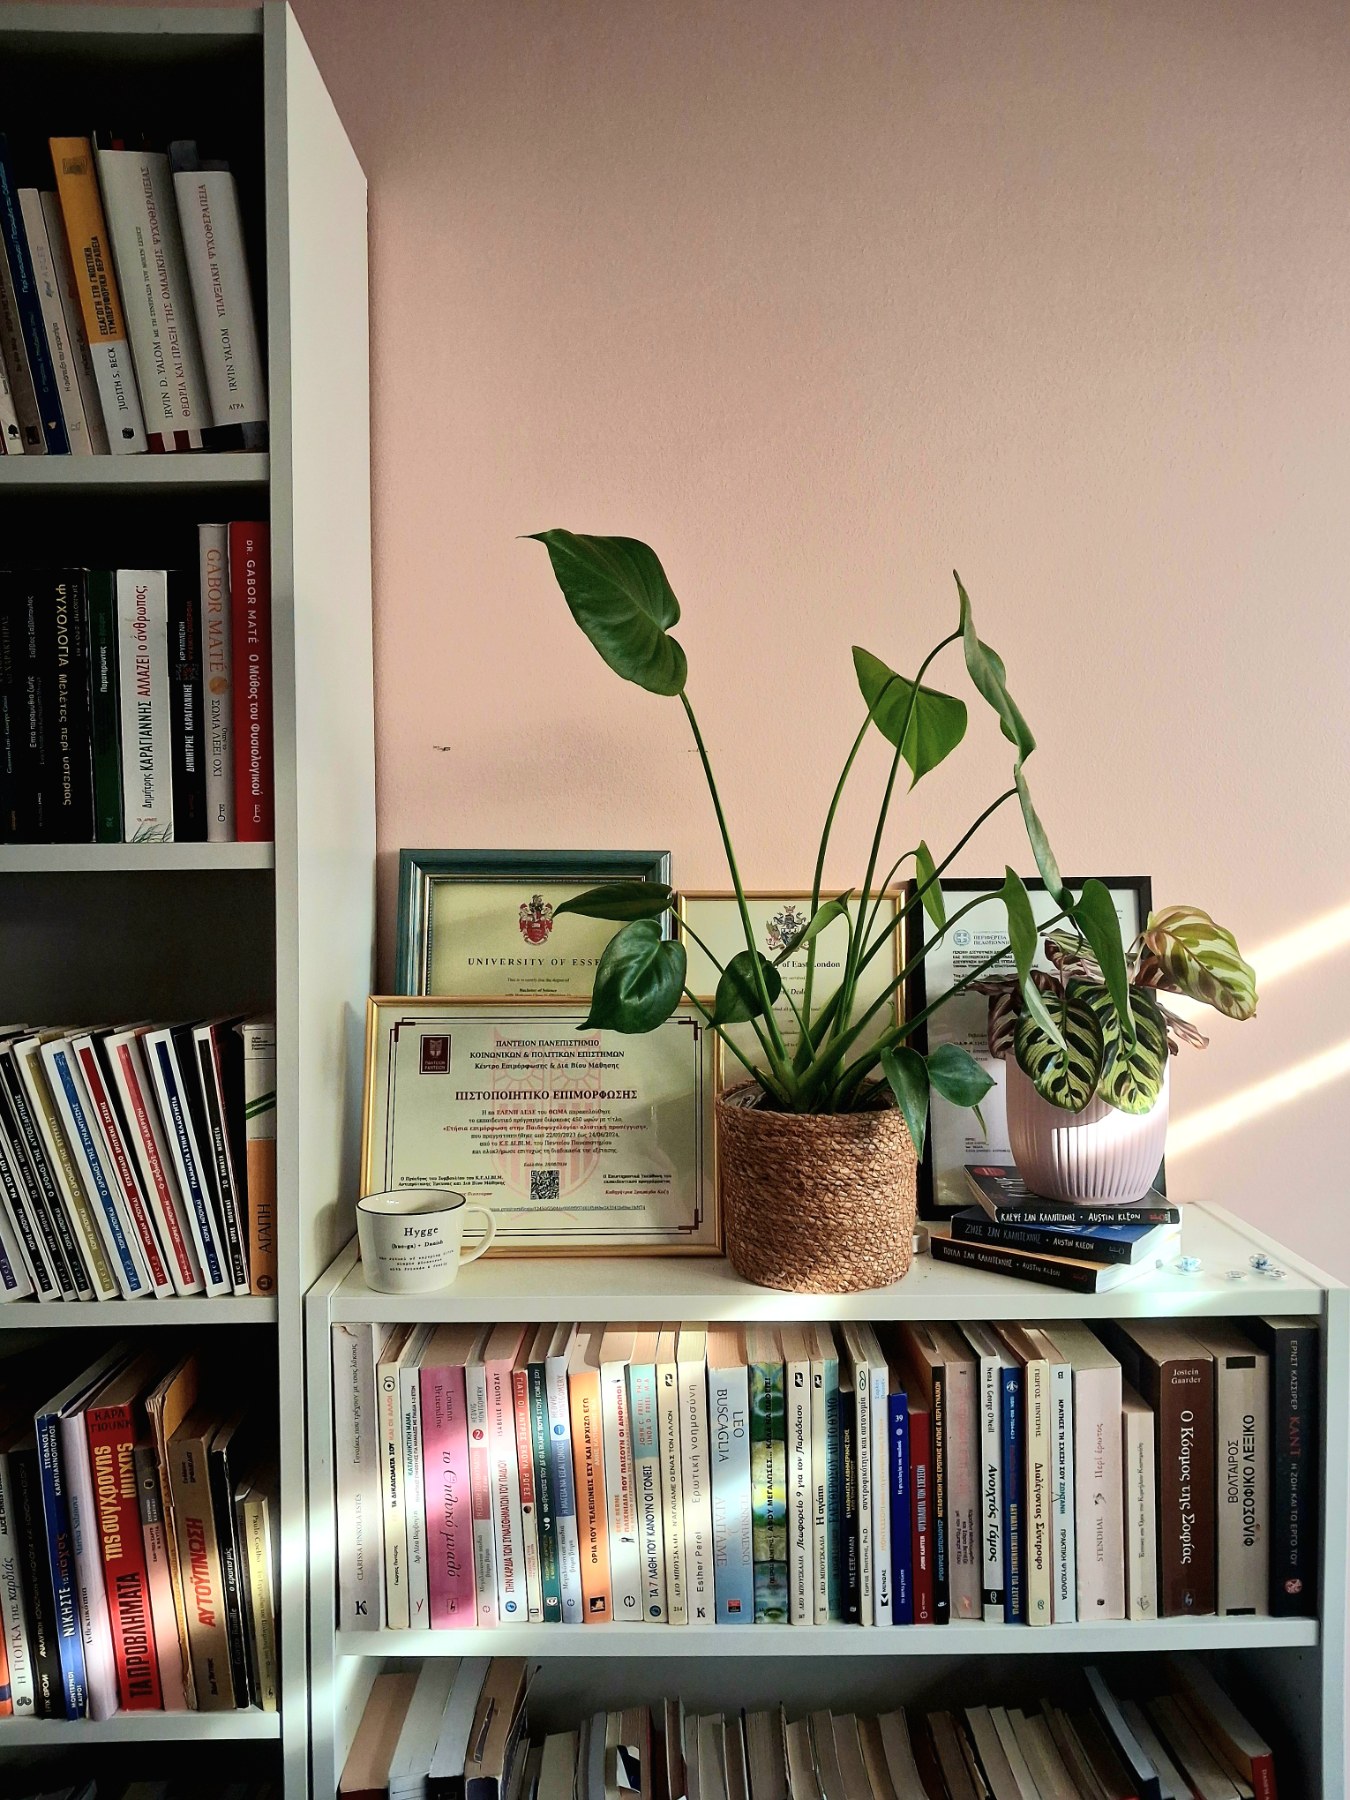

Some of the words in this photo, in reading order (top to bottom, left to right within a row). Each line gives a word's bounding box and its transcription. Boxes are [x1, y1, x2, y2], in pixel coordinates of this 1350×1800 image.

[140, 166, 162, 245] ΨΥΧΟΘΕΡΑΠΕΙΑΣ
[198, 183, 217, 259] ΨΥΧΟΘΕΡΑΠΕΙΑ
[84, 247, 100, 283] ΓΝΩΣΤΙΚΗ
[91, 236, 107, 272] ΘΕΡΑΠΕΙΑ
[154, 248, 171, 300] ΟΜΑΔΙΚΗΣ
[92, 284, 103, 298] ΣΤΗ
[99, 274, 117, 335] ΣΥΜΠΕΡΙΦΟΡΙΚΗ
[210, 263, 226, 318] ΥΠΑΡΞΙΑΚΗ
[96, 300, 109, 335] ΕΙΣΑΓΩΓΗ
[163, 303, 176, 323] ΤΗΣ
[108, 347, 119, 368] BECK
[152, 341, 166, 374] YALOM
[168, 325, 181, 359] ΠΡΑΞΗ
[220, 328, 232, 362] YALOM
[112, 370, 120, 378] S.
[158, 377, 168, 387] D.
[175, 362, 184, 378] ΚΑΙ
[227, 364, 237, 392] IRVIN
[113, 380, 129, 411] JUDITH
[161, 392, 174, 419] IRVIN
[178, 381, 191, 417] ΘΕΩΡΙΑ
[207, 549, 223, 613] GABOR
[246, 559, 257, 605] GABOR
[55, 583, 69, 667] ΨΥΧΟΛΟΓΙΑ
[131, 585, 148, 642] άνθρωπος;
[247, 609, 258, 644] MATÉ
[209, 619, 226, 672] MATÉ
[249, 654, 258, 662] Ο
[136, 654, 151, 696] ΑΛΛΑΖΕΙ
[249, 665, 260, 700] Μύθος
[58, 673, 69, 722] Μελέτες
[183, 684, 194, 731] ΚΑΡΑΓΙΑΝΝΗΣ
[250, 702, 260, 720] του
[211, 700, 221, 730] ΣΩΜΑ
[59, 727, 71, 751] περί
[138, 701, 152, 771] ΚΑΡΑΓΙΑΝΝΗΣ
[212, 731, 222, 756] ΛΕΕΙ
[184, 735, 195, 772] ΔΗΜΗΤΡΗΣ
[212, 758, 222, 777] ΟΧΙ
[249, 723, 263, 796] Φυσιολογικού
[61, 756, 73, 806] υστερίας
[142, 773, 153, 809] Δημήτρης
[468, 958, 545, 966] UNIVERSITY
[551, 958, 566, 966] OF
[572, 958, 601, 966] ESSE
[475, 1062, 499, 1070] Κέντρο
[501, 1062, 548, 1070] Επιμόρφωσης
[454, 1090, 550, 1101] ΠΙΣΤΟΠΟΙΗΤΙΚΟ
[553, 1090, 638, 1100] ΕΠΙΜΟΡΦΩΣΗΣ
[72, 1102, 91, 1146] ΣΥΝΑΝΤΗΣΗΣ
[100, 1101, 113, 1123] ΣΧΕΣΗΣ
[171, 1096, 185, 1135] ΚΛΑΟΥΝΤΙΑ
[88, 1146, 97, 1160] ΤΗΣ
[108, 1125, 122, 1154] ΕΡΩΤΙΚΗΣ
[181, 1135, 192, 1153] ΣΤΗΝ
[93, 1161, 106, 1188] ΔΡΟΜΟΣ
[118, 1155, 133, 1187] ΕΓΧΕΙΡΙΔΙΟ
[185, 1154, 198, 1189] ΓΡΑΜΜΑΤΑ
[257, 1203, 272, 1254] ΑΓΑΠΗ
[1023, 1213, 1036, 1222] ΣΑΝ
[1088, 1212, 1115, 1222] AUSTIN
[1118, 1211, 1141, 1221] KLEON
[404, 1227, 439, 1239] Hygge
[987, 1227, 1001, 1238] ΣΑΝ
[1053, 1237, 1074, 1247] AUSTIN
[1075, 1240, 1095, 1250] KLEON
[963, 1250, 976, 1260] ΣΑΝ
[1022, 1261, 1041, 1272] AUSTIN
[1042, 1266, 1061, 1277] KLEON
[1289, 1340, 1298, 1367] ΕΡΝΣΤ
[1171, 1376, 1203, 1384] Gaarder
[1173, 1368, 1199, 1376] Jostein
[446, 1390, 455, 1422] Louann
[582, 1397, 590, 1414] ΕΓΩ
[1290, 1370, 1298, 1410] ΚΑΣΣΙΡΕΡ
[434, 1385, 444, 1429] Brizendine
[686, 1384, 699, 1450] νοημοσύνη
[1180, 1410, 1193, 1422] Ο
[584, 1415, 592, 1444] ΑΡΧΙΖΩ
[716, 1388, 729, 1463] BUSCAGLIA
[732, 1410, 744, 1438] LEO
[794, 1404, 805, 1454] Παράδεισο
[1242, 1414, 1255, 1462] ΛΕΞΙΚΟ
[1289, 1416, 1301, 1457] ΚΑΝΤ
[42, 1433, 51, 1470] ΣΤΕΦΑΝΟΣ
[48, 1424, 61, 1496] ΚΑΡΑΓΙΑΝΝΟΠΟΥΛΟΣ
[795, 1456, 804, 1471] τον
[1179, 1428, 1194, 1482] Κόσμος
[585, 1462, 593, 1477] ΕΣΥ
[641, 1465, 653, 1491] ΓΟΝΕΙΣ
[689, 1454, 702, 1504] Ερωτική
[795, 1474, 805, 1489] για
[1227, 1440, 1240, 1503] ΒΟΛΤΑΙΡΟΣ
[1290, 1472, 1298, 1491] ΖΩΗ
[586, 1479, 596, 1525] ΤΕΛΕΙΩΝΕΙΣ
[643, 1493, 653, 1502] ΟΙ
[816, 1485, 826, 1515] αγάπη
[986, 1464, 999, 1519] Ανοιχτός
[1033, 1462, 1045, 1519] Διαλέγοντας
[1178, 1484, 1193, 1511] της
[1242, 1466, 1256, 1547] ΦΙΛΟΣΟΦΙΚΟ
[1290, 1493, 1298, 1508] ΚΑΙ
[252, 1514, 260, 1535] Paulo
[644, 1504, 655, 1536] ΚΑΝΟΥΝ
[795, 1501, 806, 1550] Λεωφορείο
[816, 1517, 824, 1526] Η
[1290, 1509, 1298, 1522] ΤΟ
[103, 1535, 124, 1561] της
[589, 1527, 597, 1543] ΠΟΥ
[646, 1538, 656, 1555] ΠΟΥ
[693, 1531, 703, 1556] Perel
[987, 1523, 1000, 1562] Γάμος
[1034, 1522, 1046, 1570] Σύντροφο
[1096, 1517, 1104, 1562] STENDHAL
[1179, 1513, 1196, 1565] Σοφίας
[1290, 1524, 1298, 1547] ΕΡΓΟ
[590, 1544, 598, 1564] ΟΡΙΑ
[647, 1556, 658, 1579] ΛΑΘΗ
[1290, 1548, 1298, 1566] ΤΟΥ
[2, 1557, 20, 1601] καρδιάς
[186, 1518, 216, 1627] ΑΥΤΟΫΠΝΩΣΗ
[695, 1559, 704, 1592] Esther
[649, 1588, 659, 1598] ΤΑ
[11, 1604, 19, 1621] ΤΗΣ
[58, 1587, 76, 1637] ΝΙΚΗΣΤΕ
[117, 1572, 151, 1677] ΠΡΟΒΛΗΜΑΤΑ
[10, 1625, 25, 1671] ΓΙΟΓΚΑ
[17, 1676, 27, 1684] Η
[129, 1678, 153, 1698] ΤΑ
